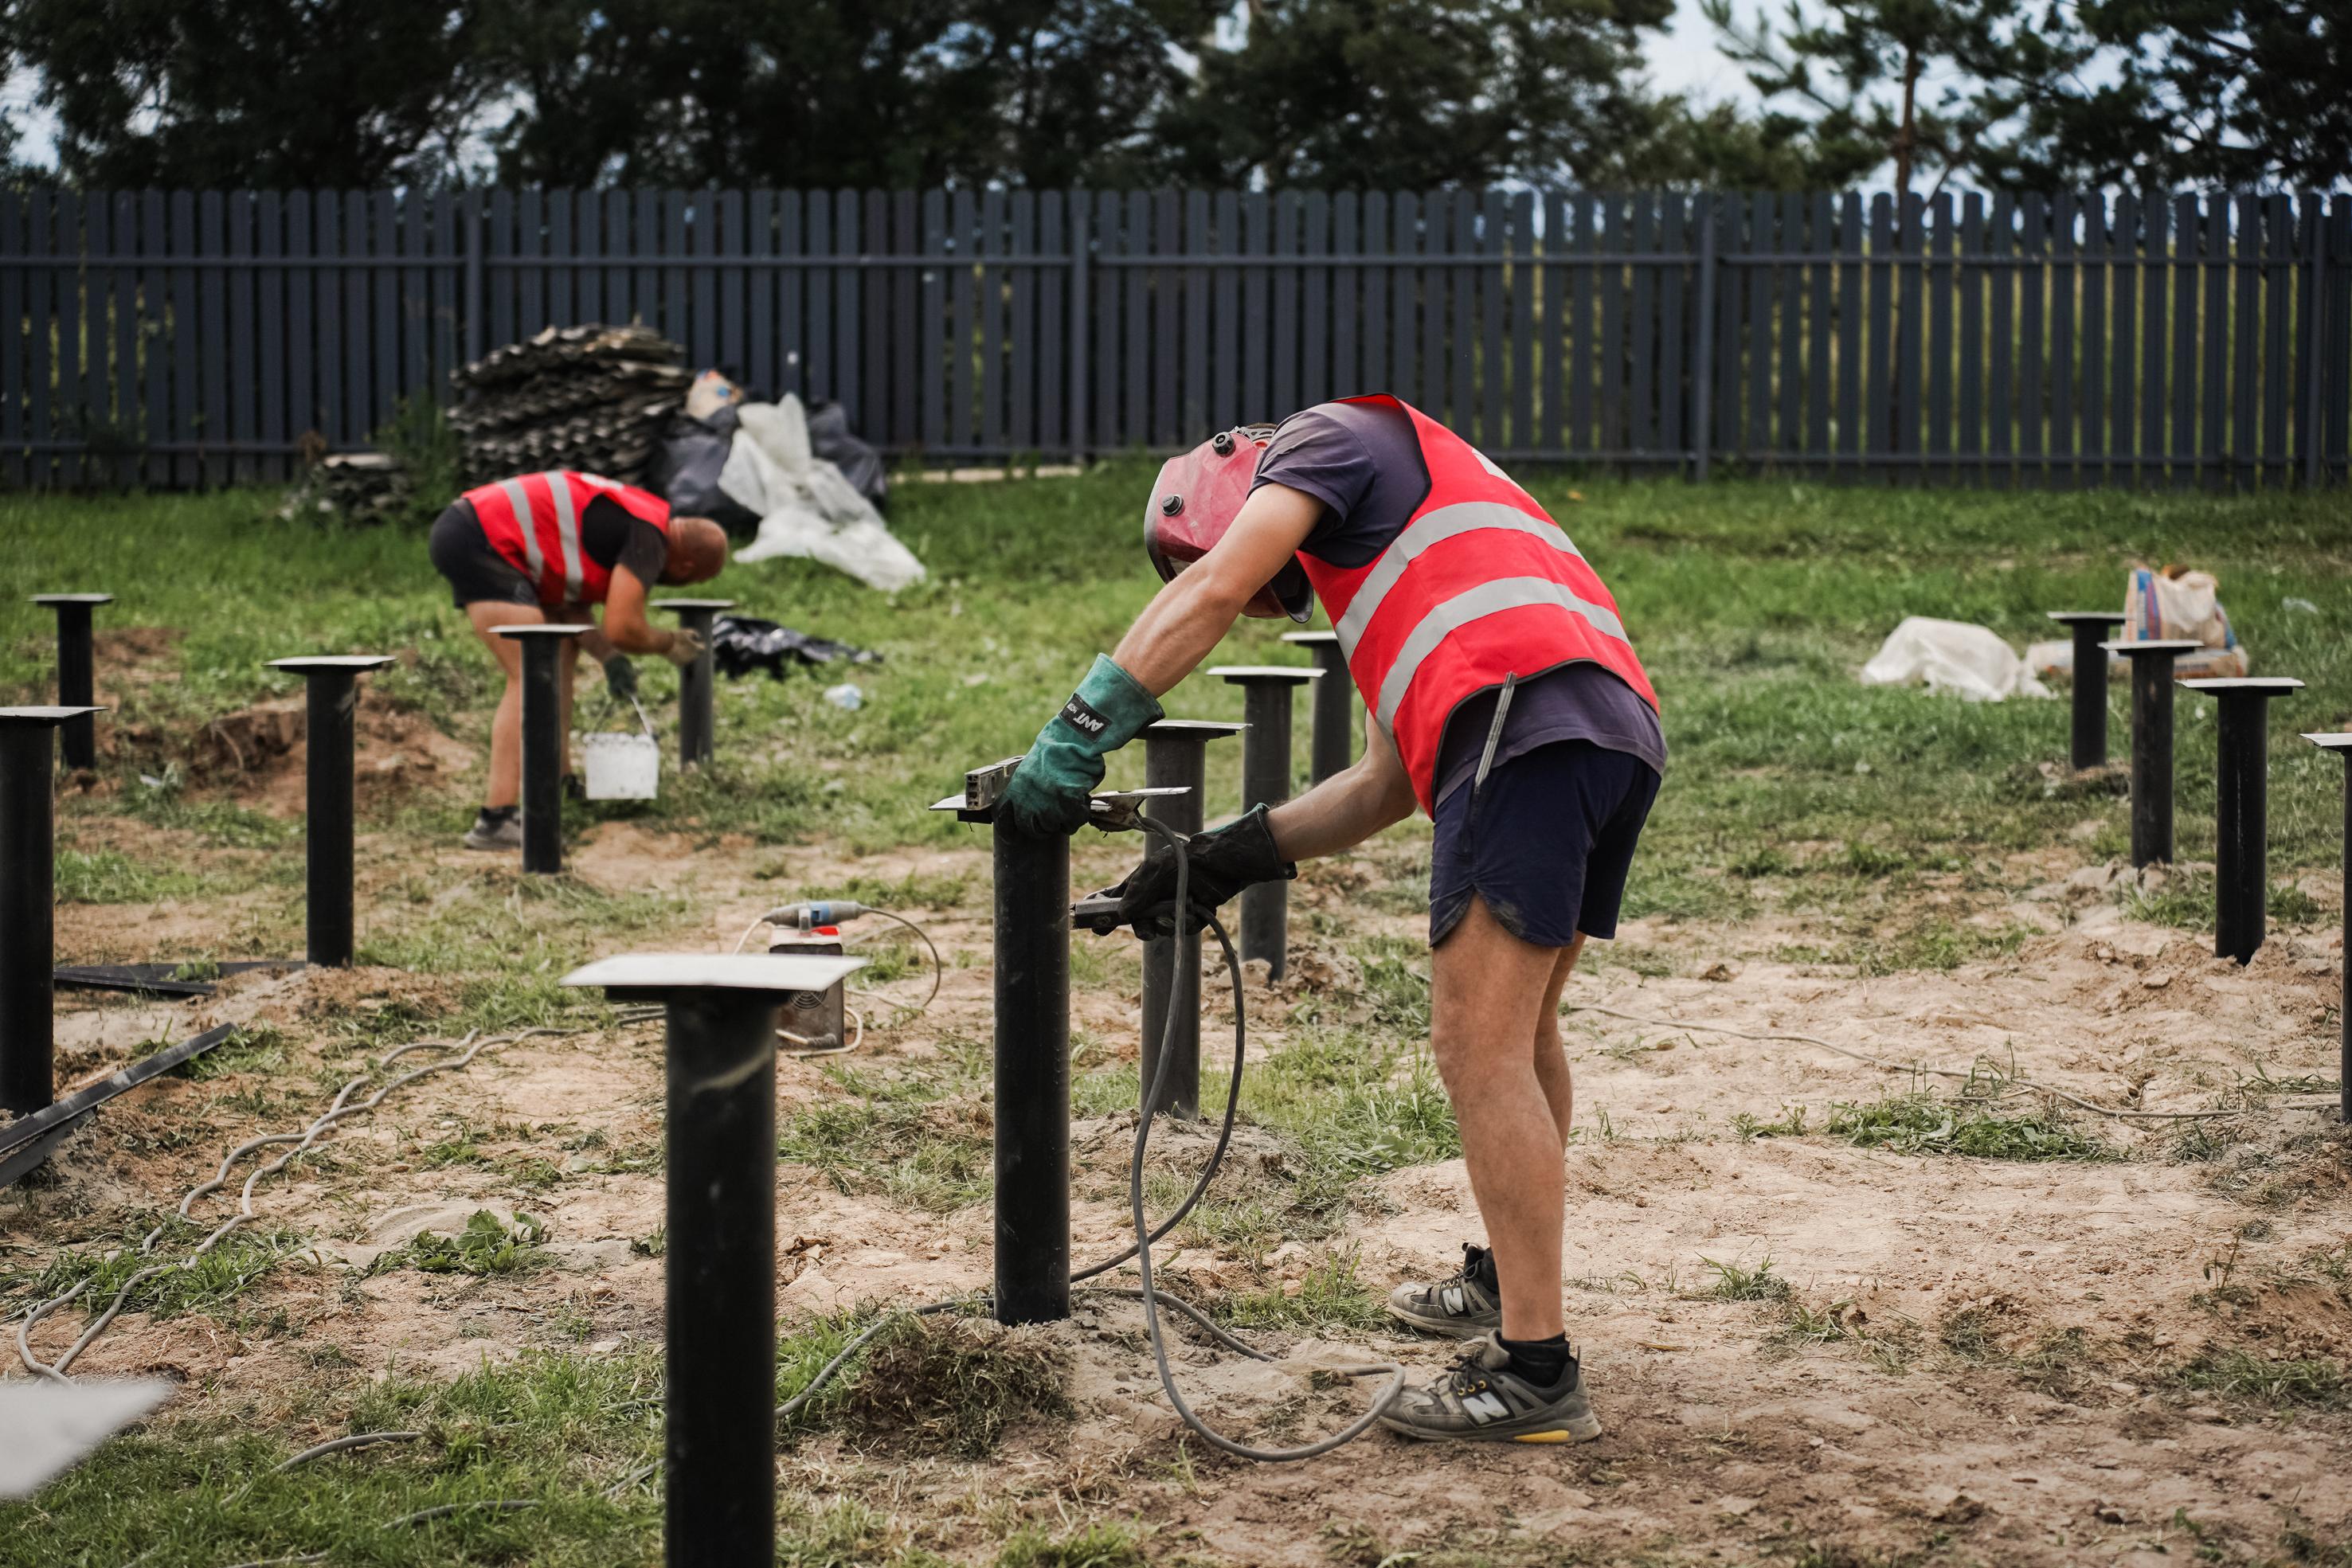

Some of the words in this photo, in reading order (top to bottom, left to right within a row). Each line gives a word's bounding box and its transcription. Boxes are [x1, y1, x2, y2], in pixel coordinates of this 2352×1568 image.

[1073, 713, 1104, 732] ANT
[1442, 1288, 1463, 1315] N
[1462, 1392, 1509, 1425] N
